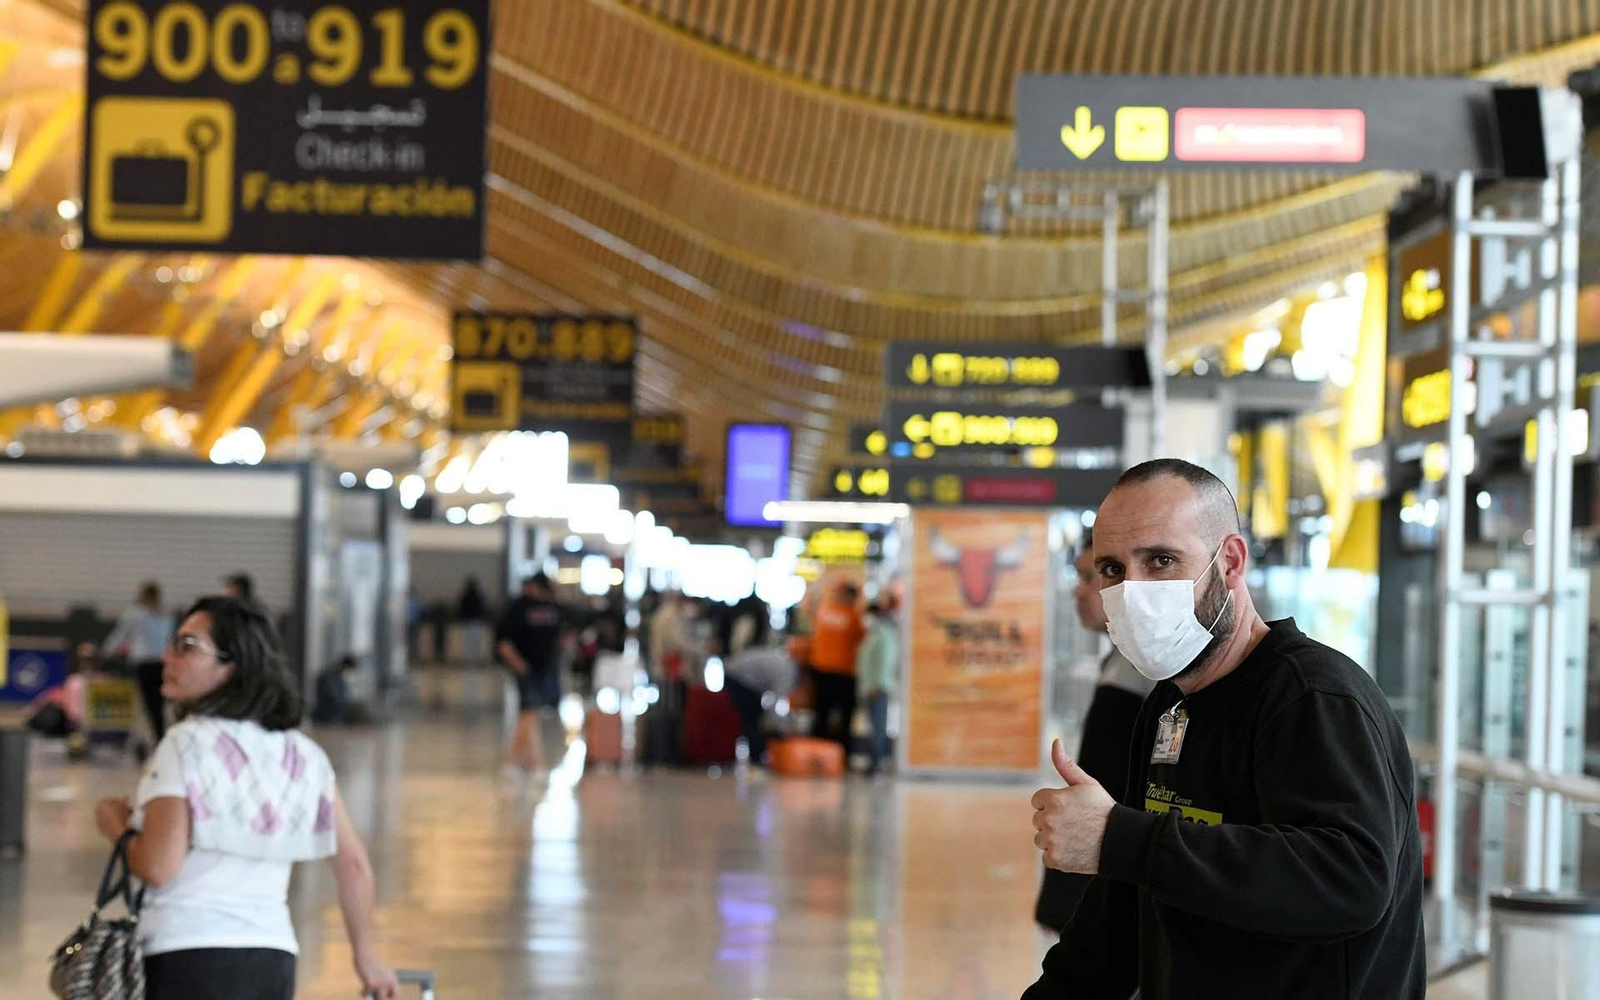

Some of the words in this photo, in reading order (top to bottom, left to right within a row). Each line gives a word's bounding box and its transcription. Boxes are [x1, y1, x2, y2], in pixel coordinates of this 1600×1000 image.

[94, 3, 270, 84] 900
[307, 7, 480, 89] 919
[240, 171, 476, 218] Facturación
